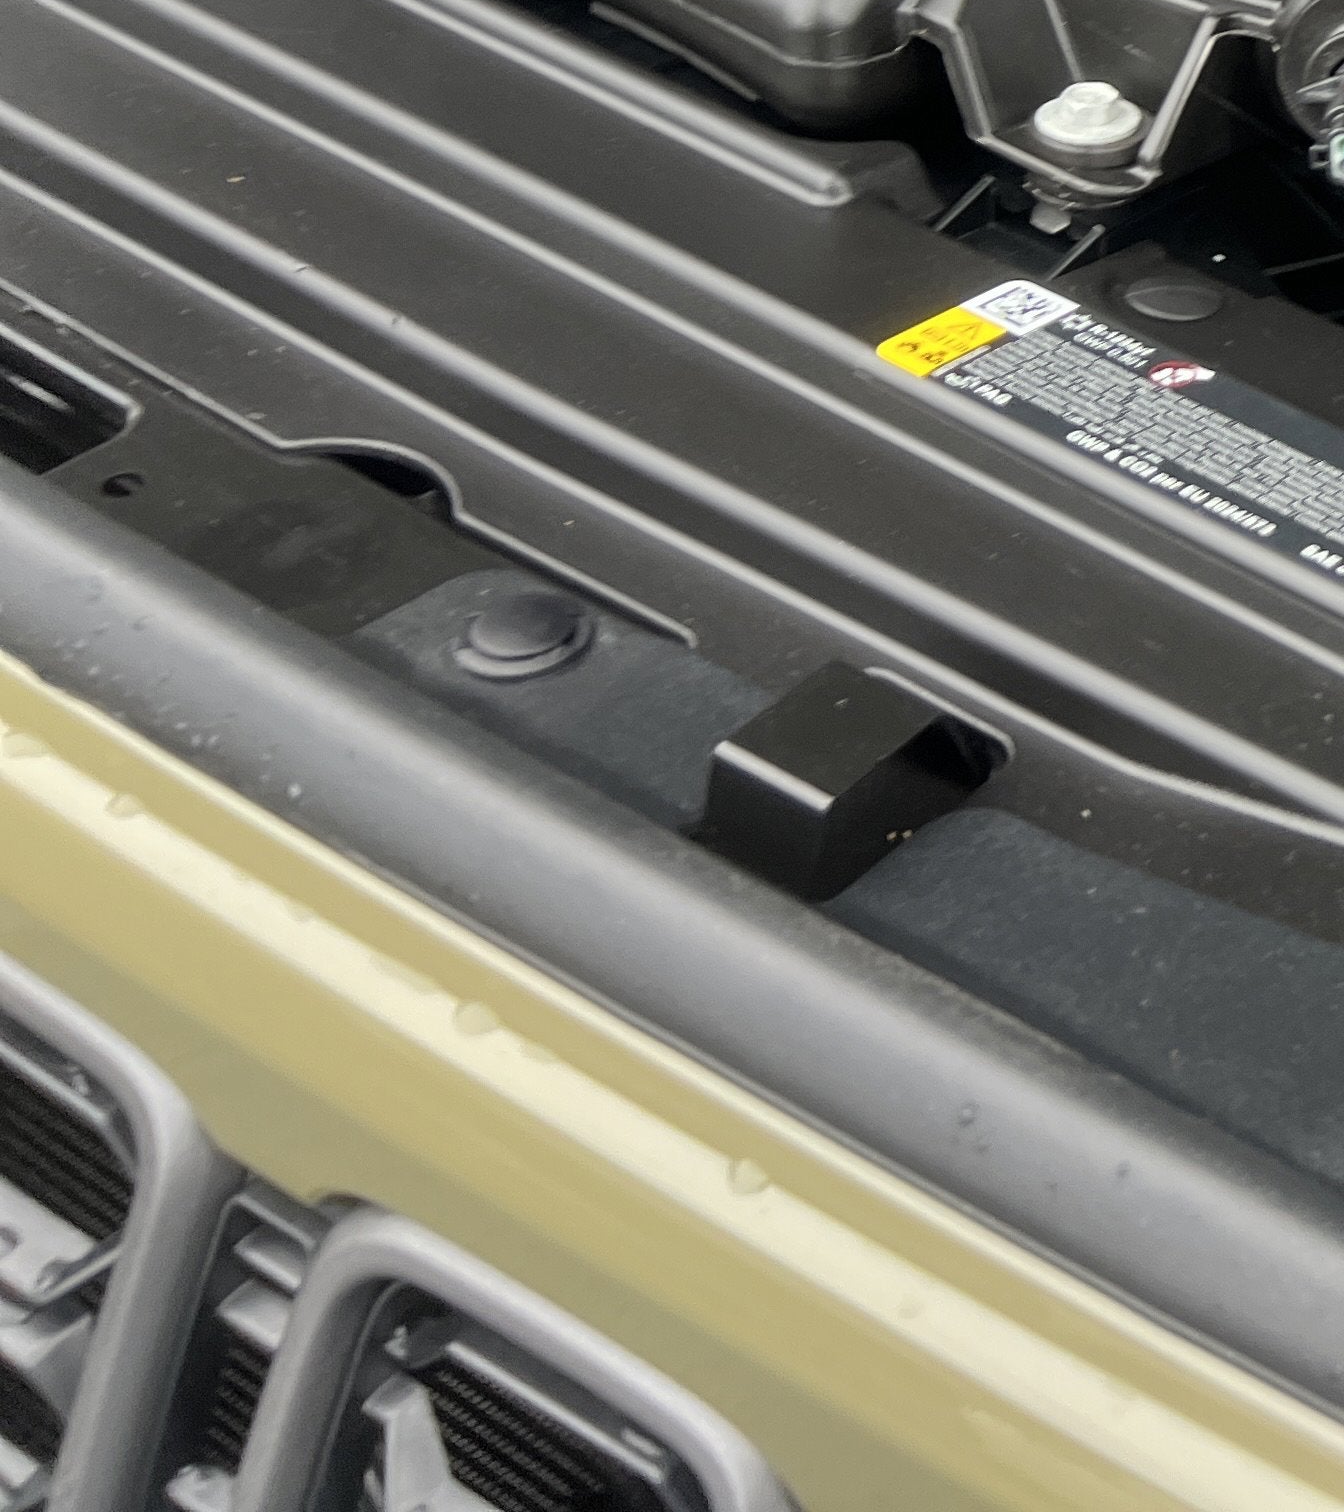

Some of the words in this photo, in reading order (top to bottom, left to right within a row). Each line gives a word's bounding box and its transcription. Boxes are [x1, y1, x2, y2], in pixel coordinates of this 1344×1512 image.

[1066, 429, 1110, 452] GWP
[1148, 472, 1185, 490] per
[1178, 484, 1211, 504] EU
[1300, 544, 1343, 569] SAE
